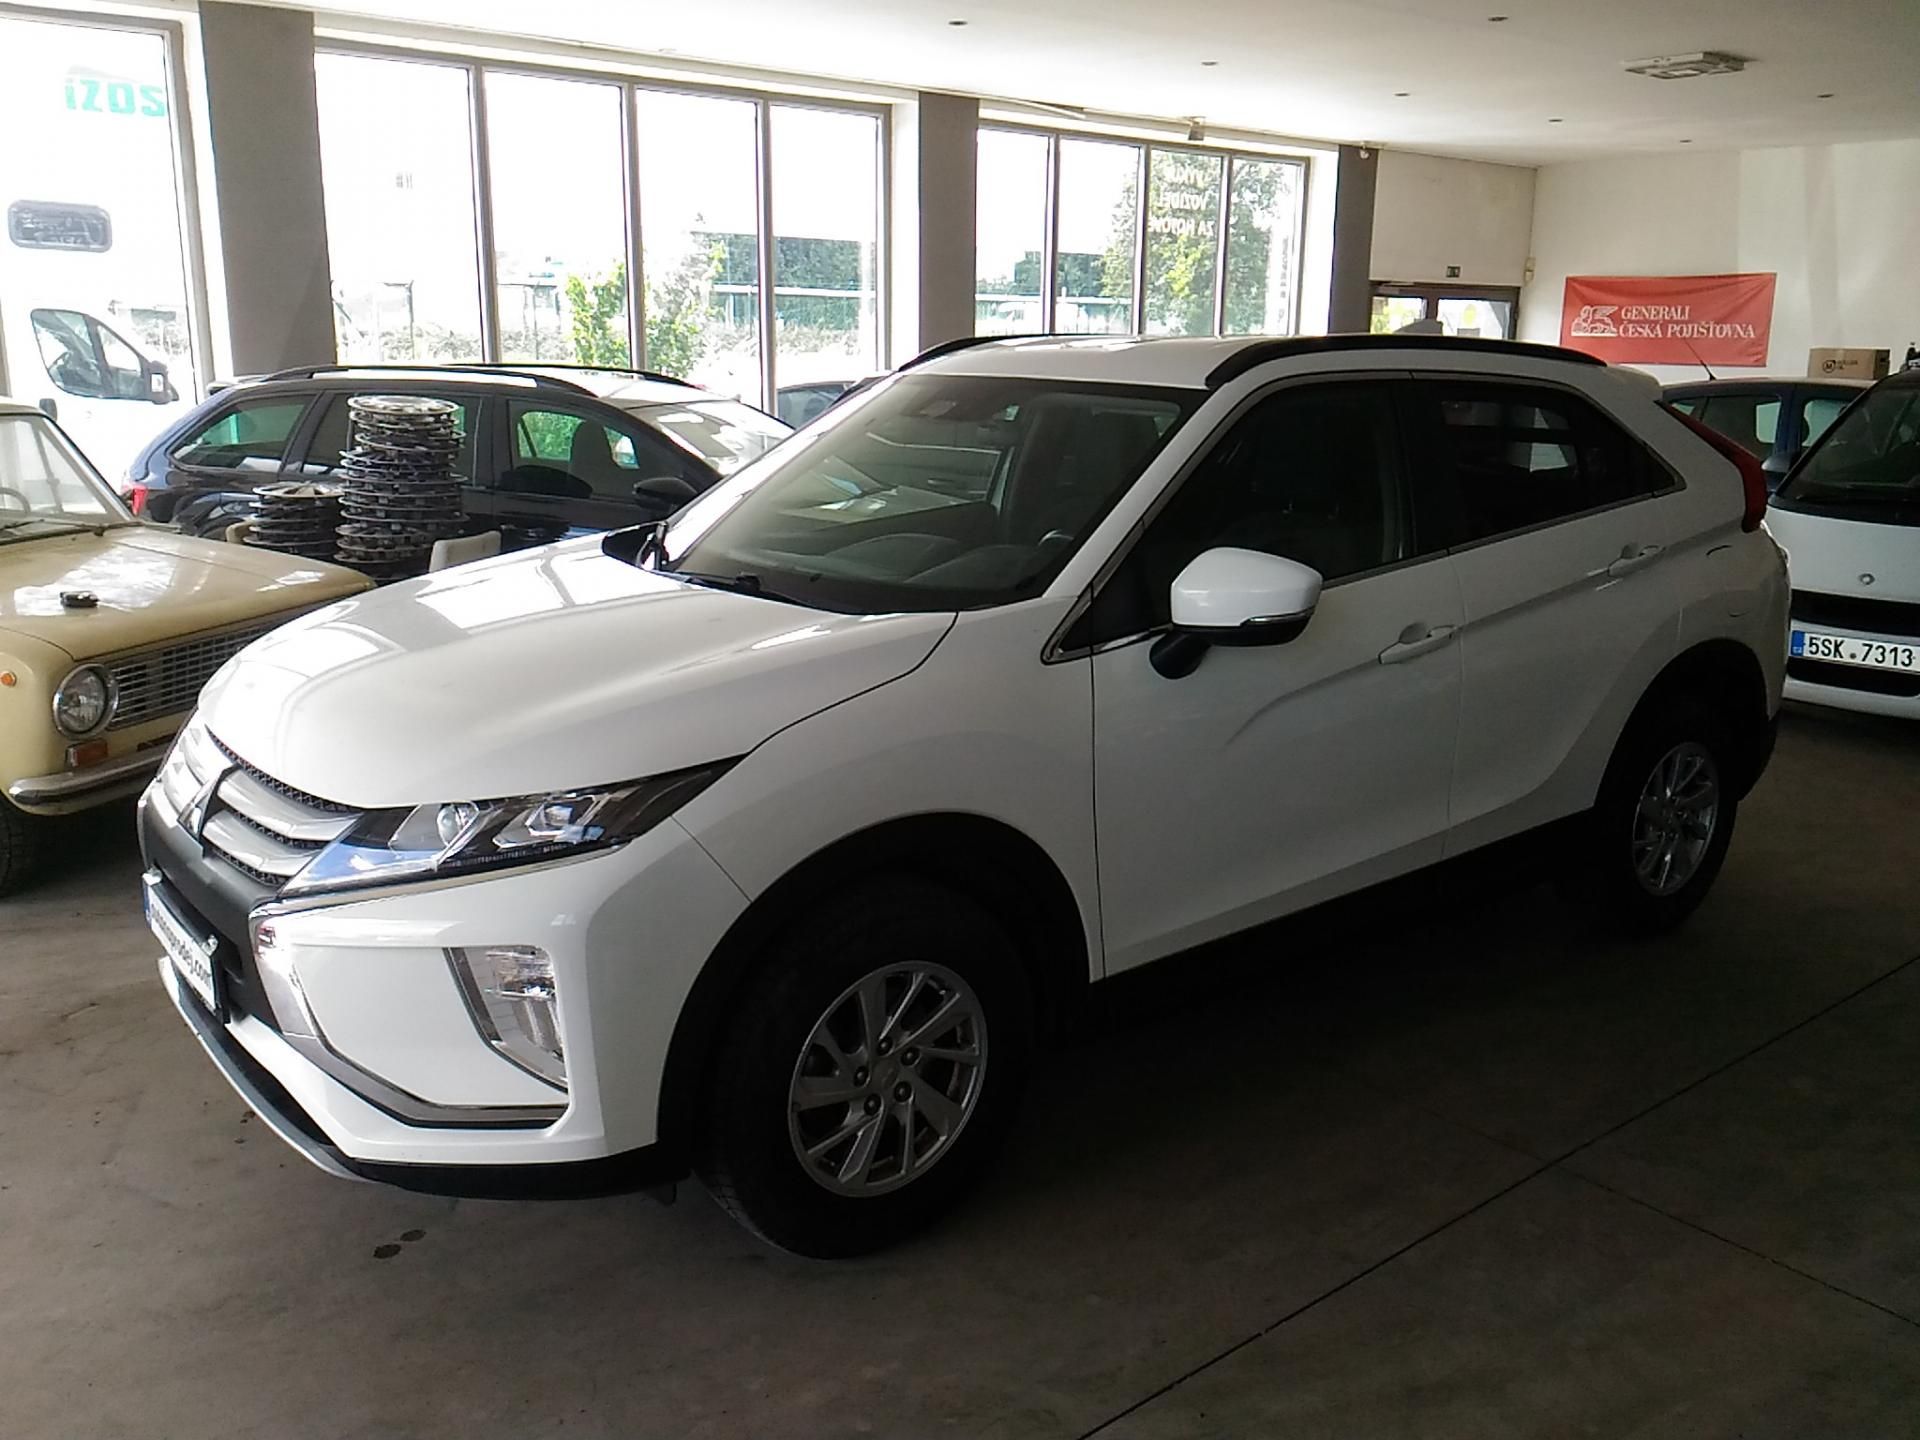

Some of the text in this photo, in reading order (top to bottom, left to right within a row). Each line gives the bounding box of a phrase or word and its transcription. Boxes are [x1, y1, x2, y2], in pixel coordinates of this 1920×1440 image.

[1621, 304, 1690, 320] GENERALI
[1619, 319, 1756, 339] ČESKÁ POJIŠŤOVNA
[1808, 636, 1914, 667] 5SK 7313
